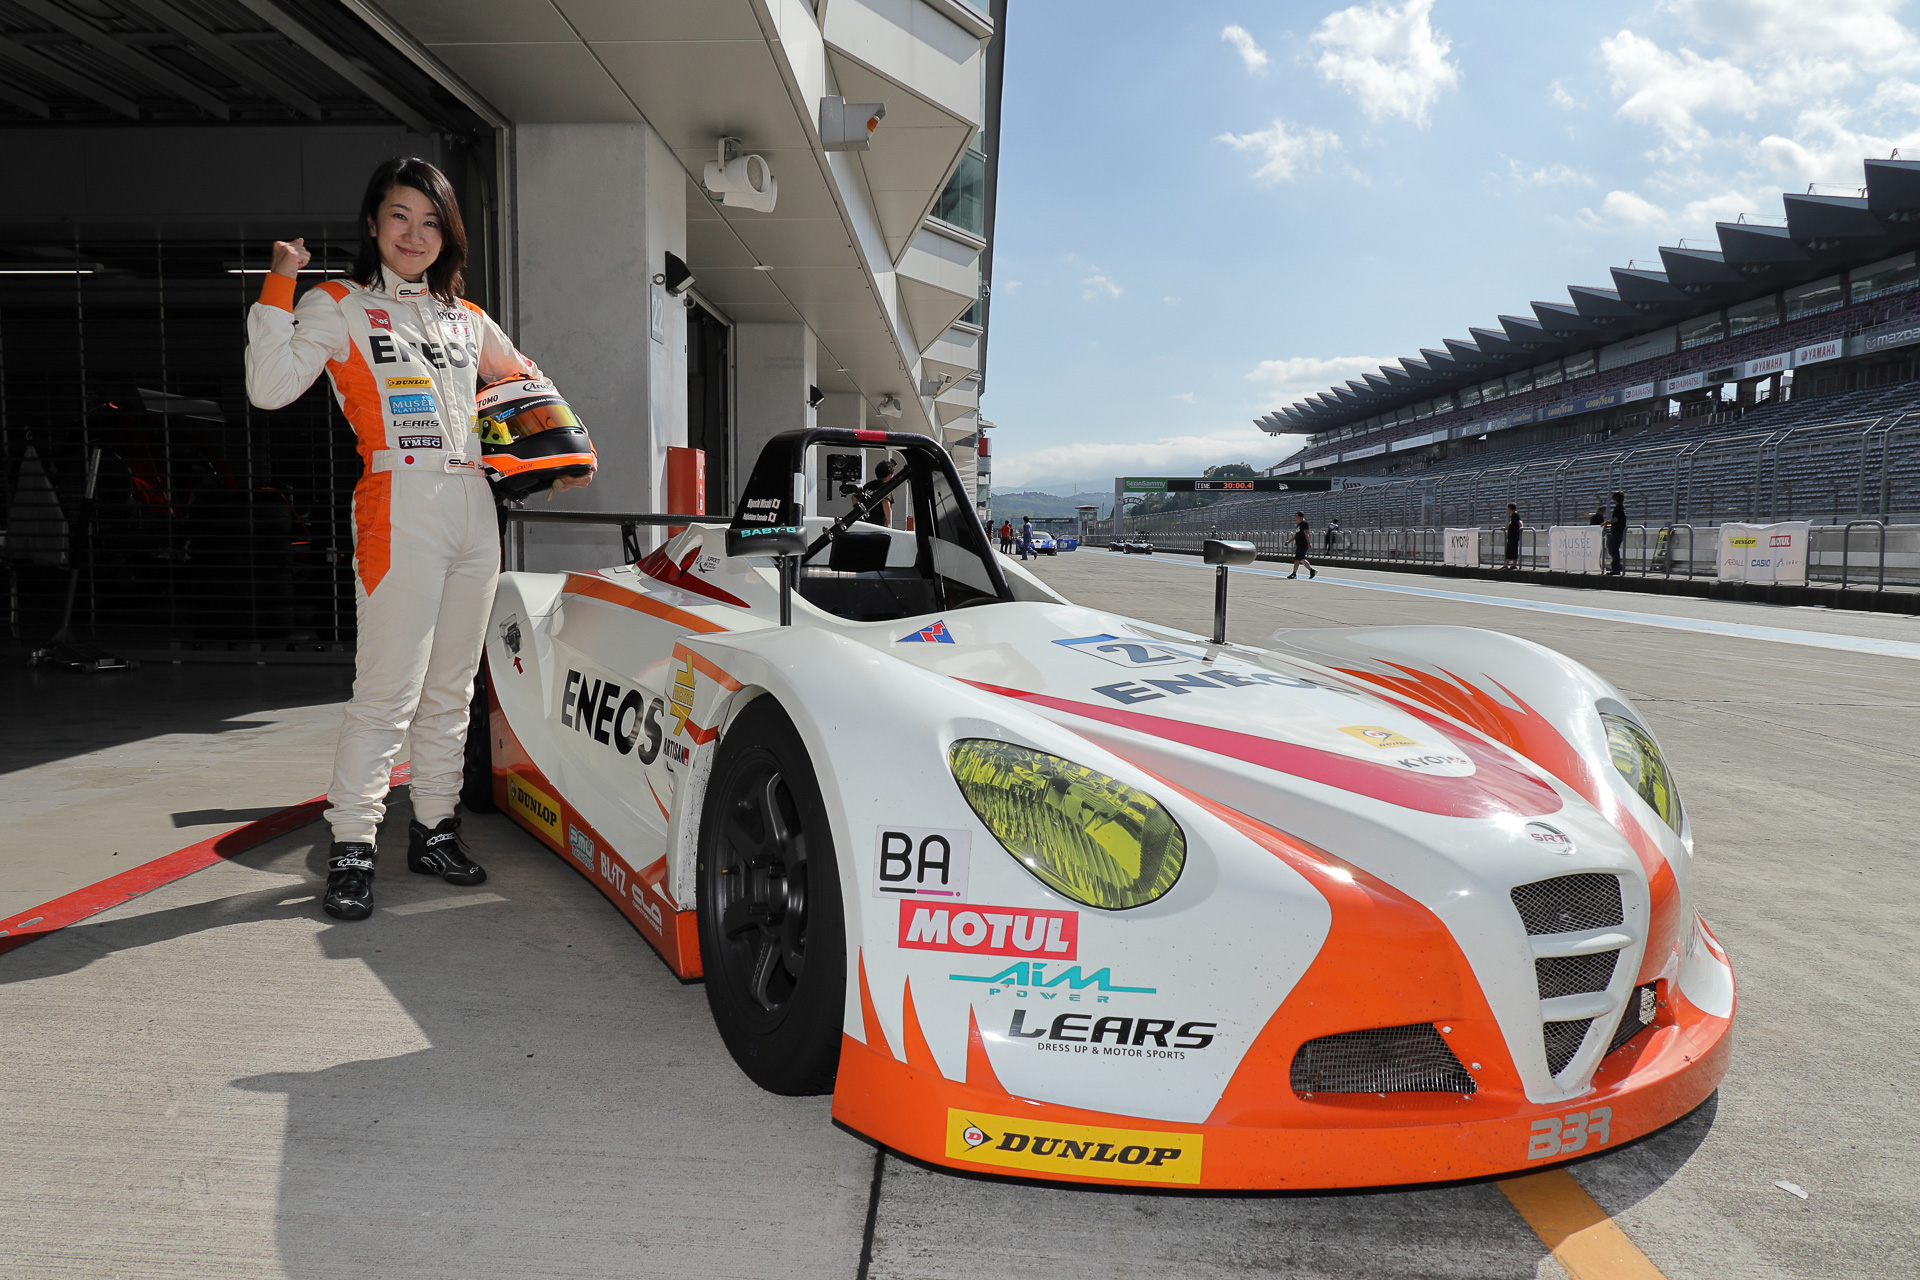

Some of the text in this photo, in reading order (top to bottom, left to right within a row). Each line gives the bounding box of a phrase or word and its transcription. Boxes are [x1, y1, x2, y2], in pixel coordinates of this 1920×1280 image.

[652, 294, 664, 336] 22
[1808, 344, 1836, 361] YAMAHA
[1758, 357, 1783, 372] YAMAHA
[1675, 376, 1700, 389] DAIHATSU
[393, 406, 436, 414] PLATINUM
[401, 439, 441, 447] TMSC
[1769, 536, 1790, 546] MOTUL
[1751, 559, 1771, 568] CASIO
[1091, 669, 1361, 705] ENEOS
[561, 668, 665, 766] ENEOS
[518, 787, 557, 827] DUNLOP
[1530, 833, 1567, 843] SRT
[878, 830, 952, 886] BA
[600, 850, 627, 898] BLITZ
[905, 907, 1070, 953] MOTUL
[988, 987, 1110, 1004] POWER
[1008, 1008, 1218, 1050] LEARS
[1037, 1042, 1186, 1060] DRESS UP & MOTOR SPORTS
[995, 1131, 1182, 1167] DUNLOP
